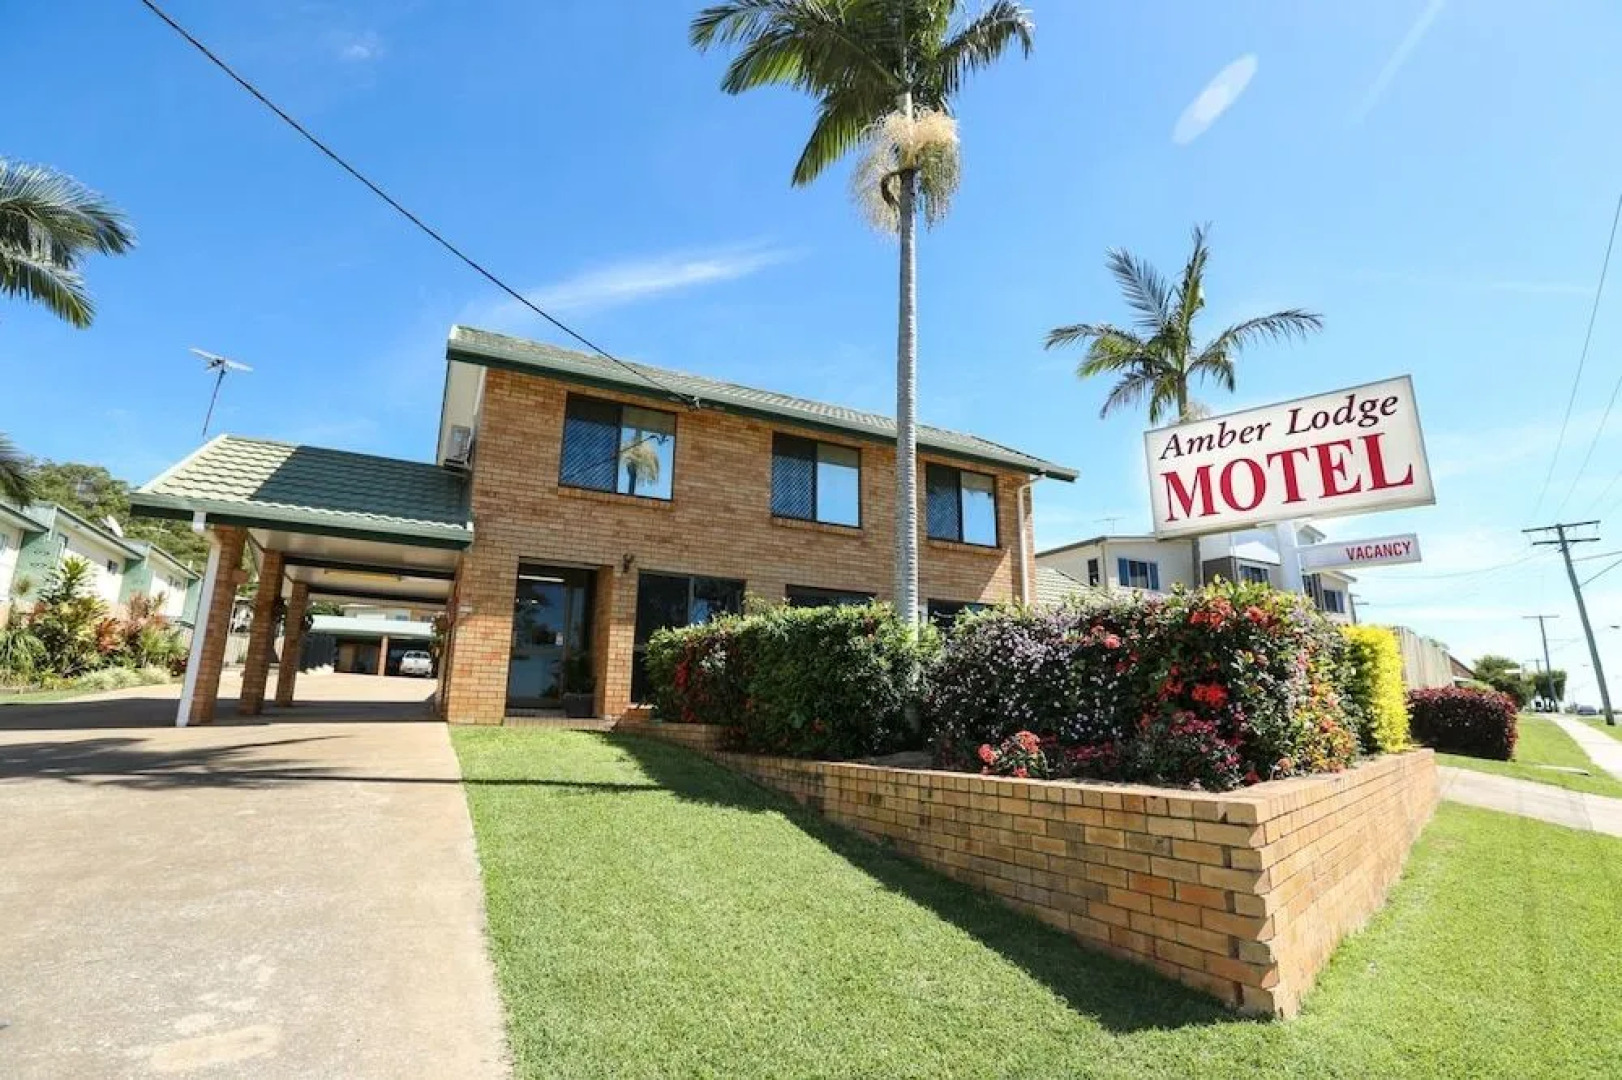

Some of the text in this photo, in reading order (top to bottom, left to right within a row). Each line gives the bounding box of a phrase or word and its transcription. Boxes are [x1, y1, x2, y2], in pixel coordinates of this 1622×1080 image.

[1160, 393, 1399, 460] Amber Lodge
[1160, 432, 1414, 522] MOTEL
[1345, 540, 1413, 561] VACANCY
